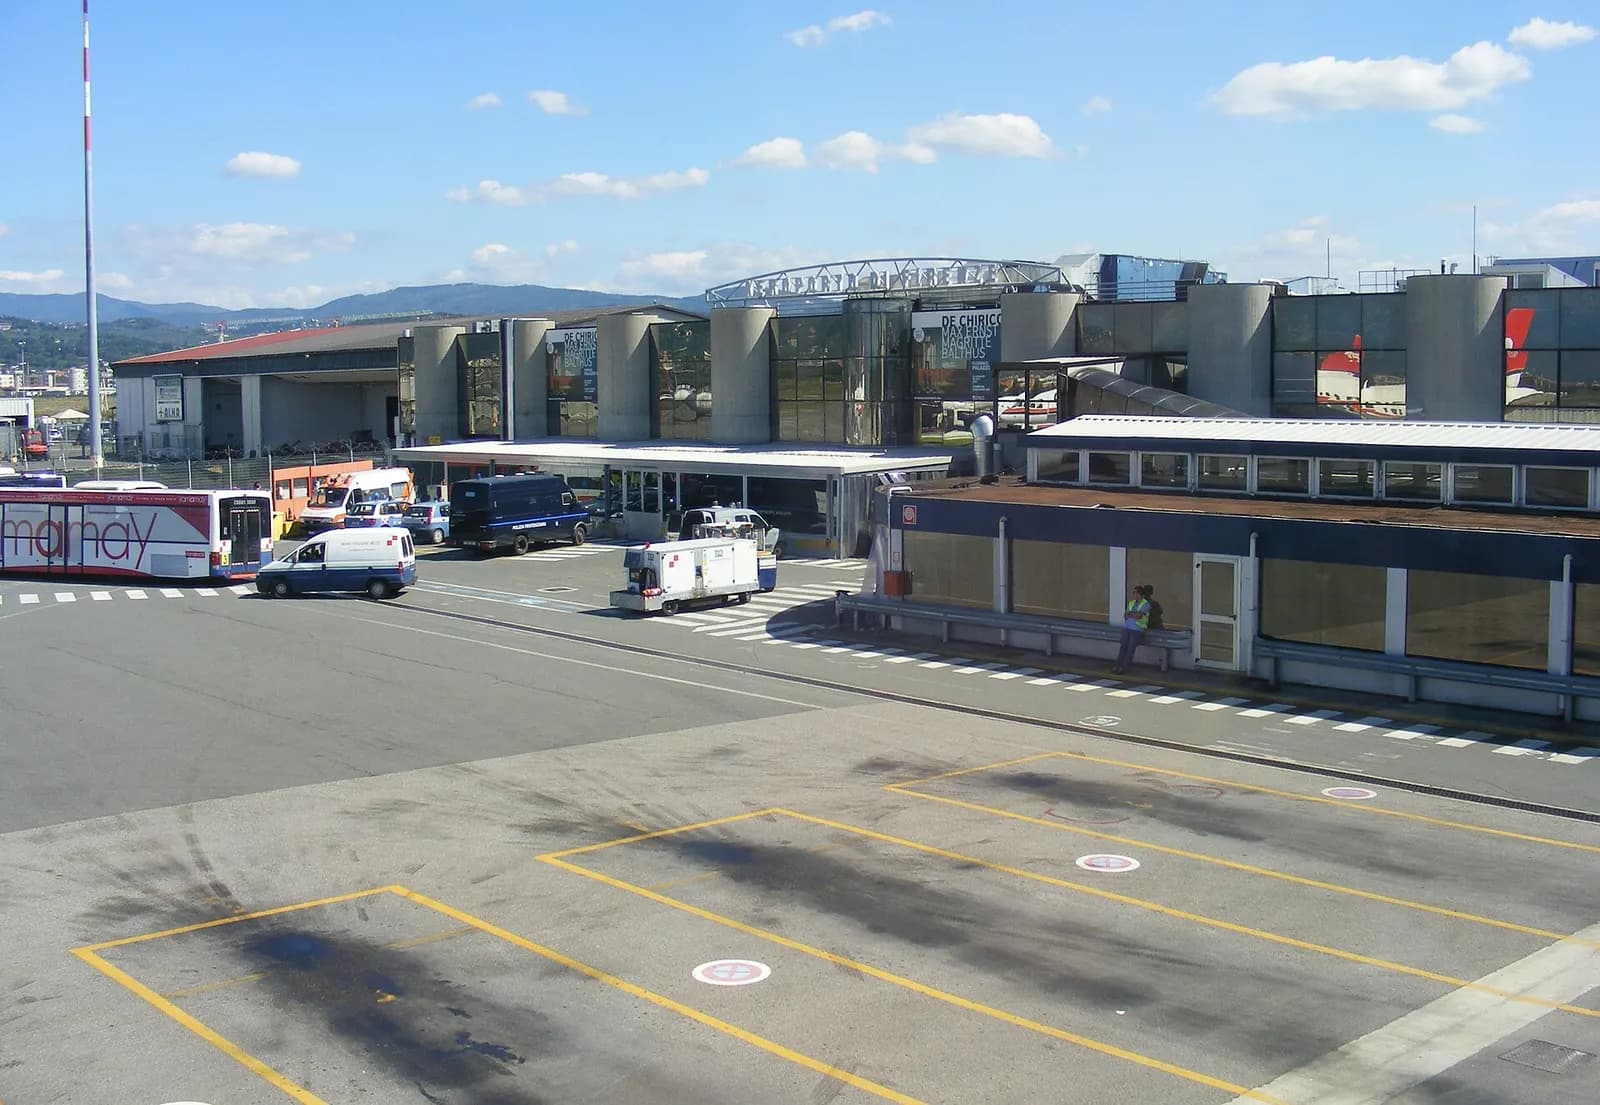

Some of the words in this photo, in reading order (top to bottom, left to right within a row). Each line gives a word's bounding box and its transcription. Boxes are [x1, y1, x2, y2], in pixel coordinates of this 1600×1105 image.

[942, 315, 956, 327] DE
[564, 332, 573, 341] DE
[941, 326, 963, 338] MAX
[966, 325, 998, 338] ERNST
[941, 336, 992, 348] MAGRITTE
[941, 347, 986, 359] BALTHUS
